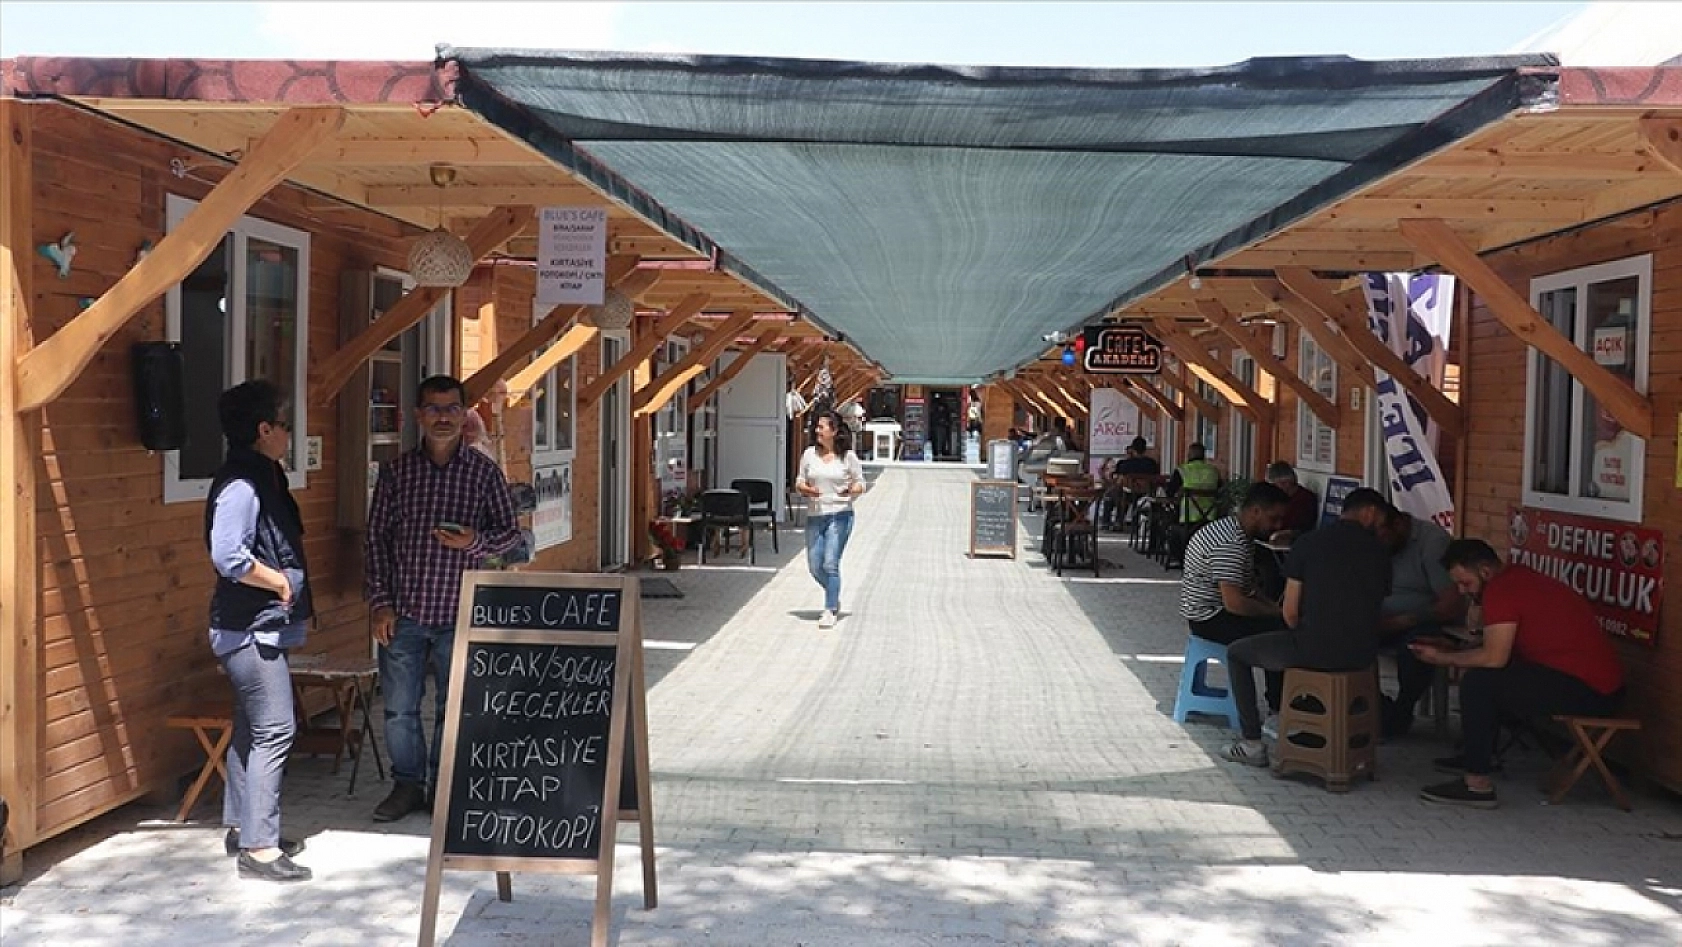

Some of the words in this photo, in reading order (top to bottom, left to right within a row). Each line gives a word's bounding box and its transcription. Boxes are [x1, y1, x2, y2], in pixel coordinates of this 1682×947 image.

[1106, 336, 1142, 353] CAFE
[1094, 421, 1135, 436] AREL
[1548, 521, 1615, 560] DEFNE
[473, 605, 532, 625] BLUES
[541, 591, 616, 626] CAFE
[469, 729, 602, 769] KIRTASİYE
[468, 771, 561, 802] KİTAP
[462, 805, 599, 849] FOTOKOPİ
